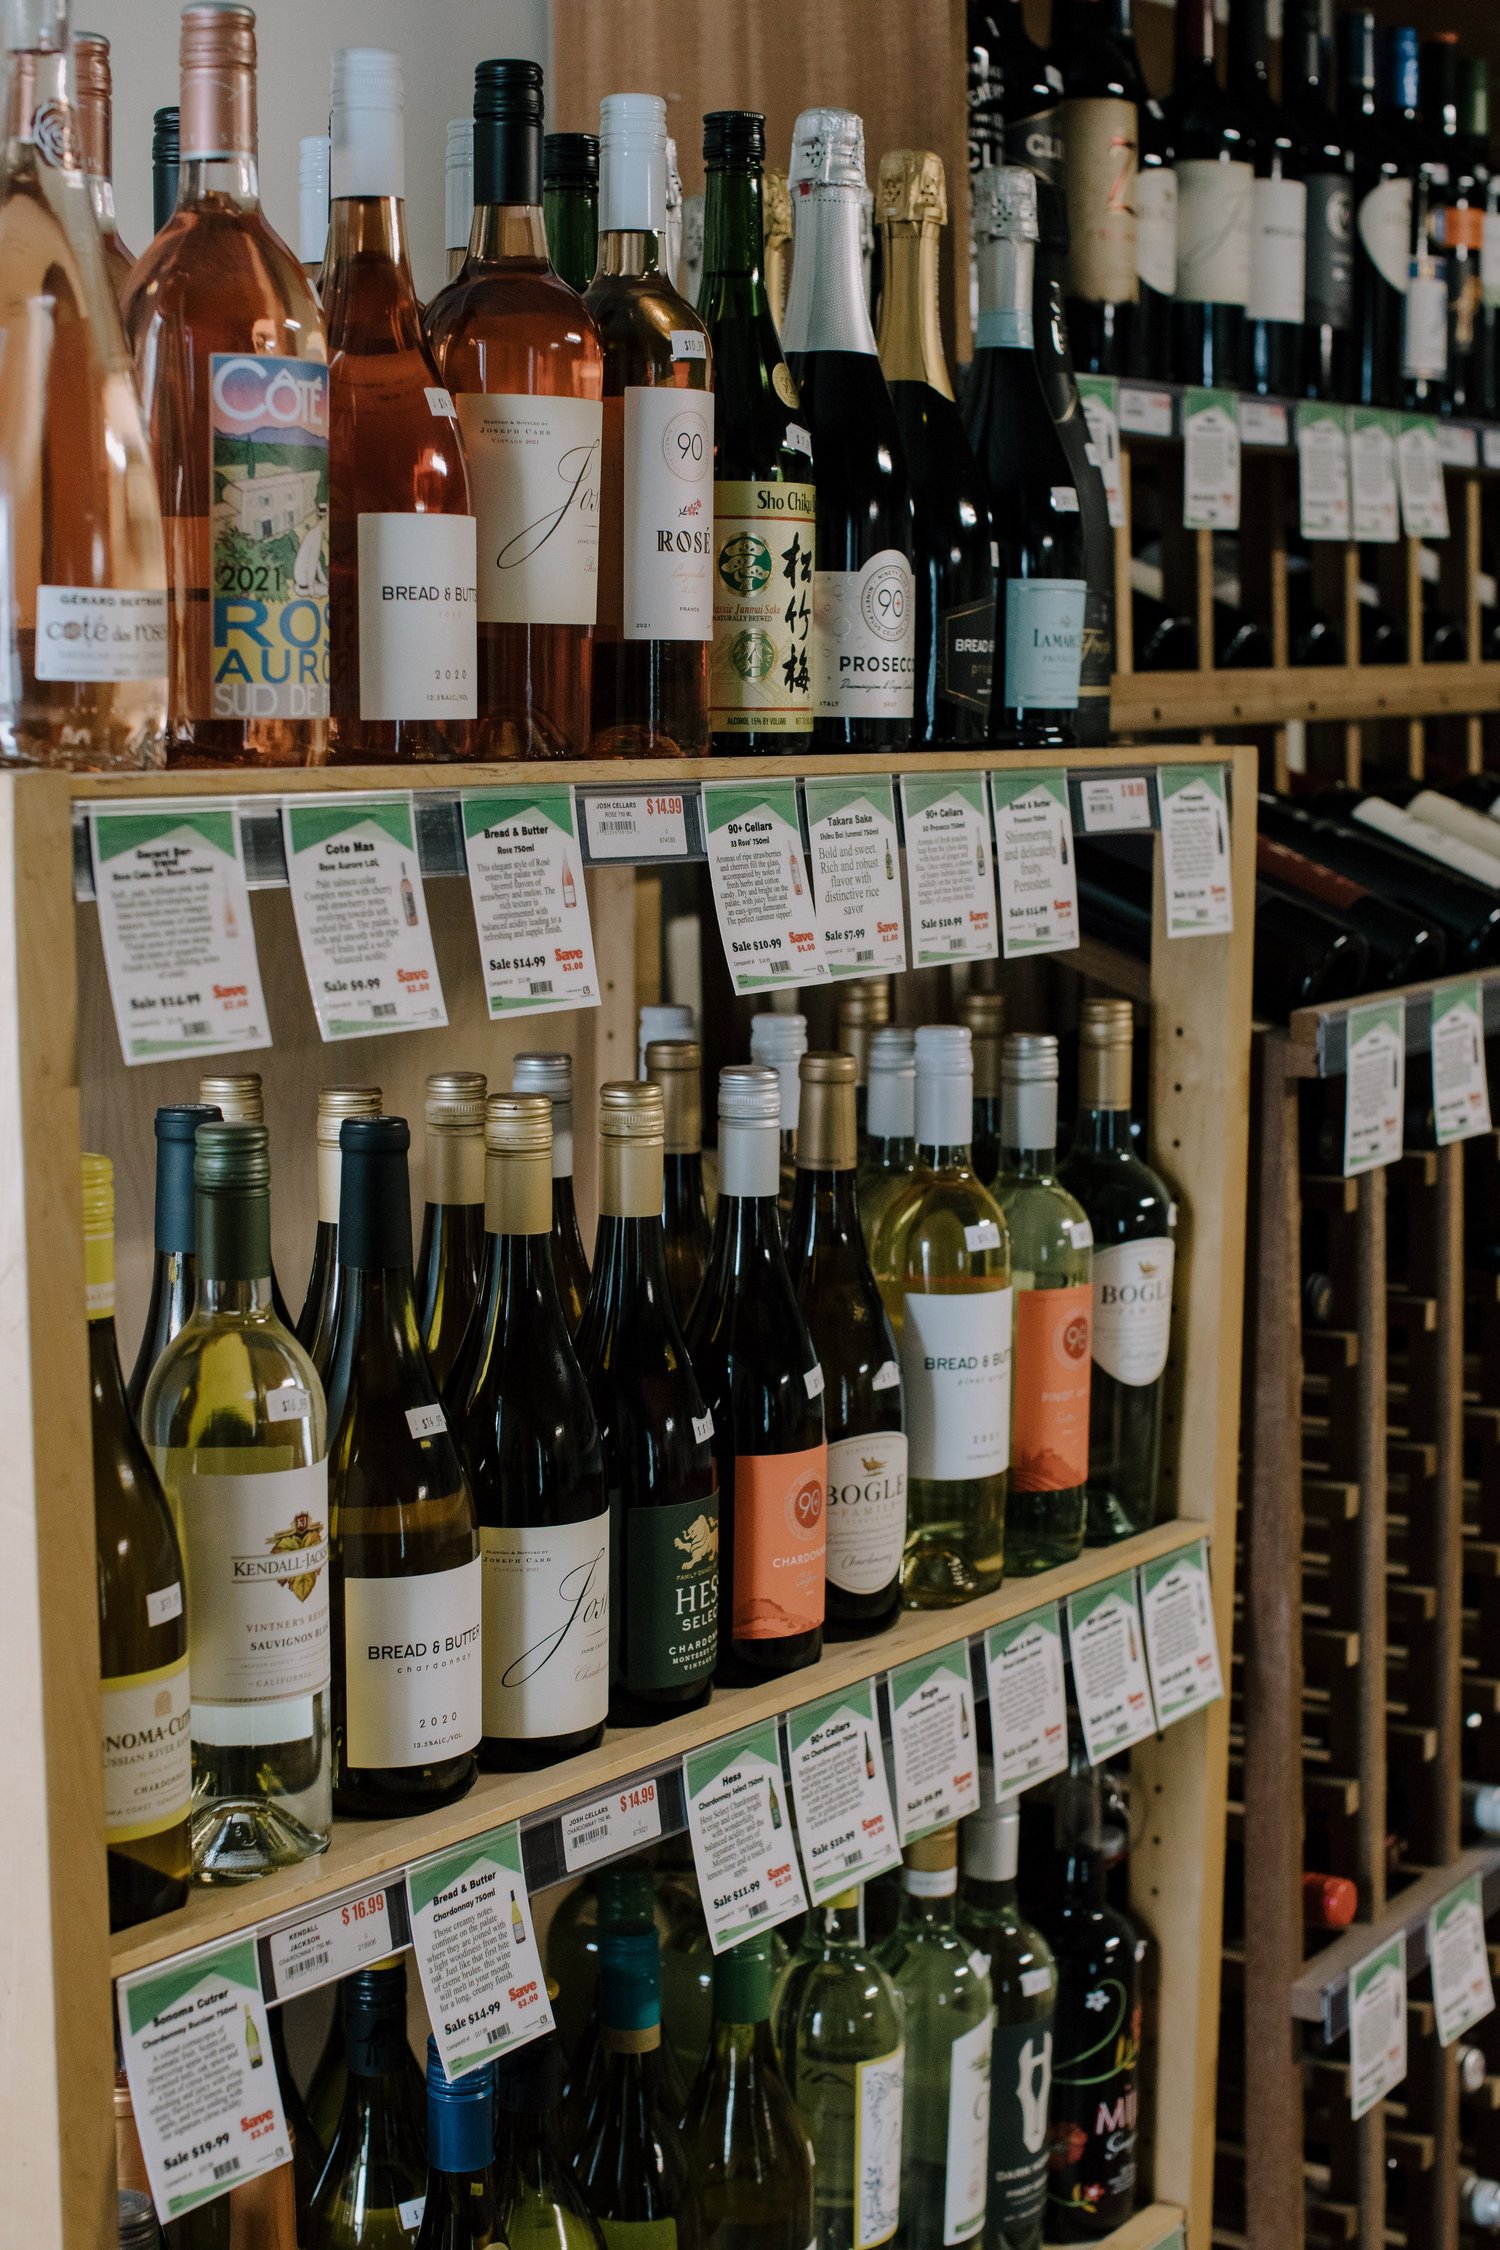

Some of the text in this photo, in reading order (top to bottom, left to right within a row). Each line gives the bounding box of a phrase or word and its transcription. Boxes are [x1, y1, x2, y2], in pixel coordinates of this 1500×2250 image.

[678, 432, 703, 461] 90
[757, 490, 784, 510] Sho
[656, 527, 710, 554] ROSÉ
[220, 566, 283, 592] 2021
[382, 586, 439, 600] BREAD
[445, 587, 451, 601] &
[713, 604, 781, 615] lassic Junmai Sake
[878, 589, 904, 617] 90
[781, 531, 813, 695] 松竹梅
[955, 638, 988, 652] BREAD
[435, 670, 467, 680] 2020
[214, 683, 278, 716] SUD
[290, 684, 317, 716] DE
[727, 716, 749, 726] ALCOHOL
[827, 815, 872, 827] Takara Sake
[925, 808, 964, 819] 90+ Cellars
[484, 826, 548, 839] Bread & Butter
[728, 822, 773, 834] 90+ Cellars
[325, 841, 374, 855] Cote Mas
[497, 843, 535, 855] Rose 750ml
[753, 836, 770, 845] 750ml
[818, 847, 838, 860] Bold
[839, 845, 853, 857] and
[820, 857, 879, 874] Rich and robust
[830, 872, 872, 887] flavor with
[825, 886, 880, 903] distinctive rice
[843, 904, 864, 916] savor
[1009, 907, 1025, 918] Sale
[1054, 899, 1072, 911] Save
[921, 917, 963, 929] Sale $10.99
[969, 910, 989, 922] Save
[825, 928, 865, 942] Sale $7.99
[877, 921, 898, 934] Save
[732, 938, 782, 952] Sale $10.99
[788, 931, 814, 944] Save
[489, 956, 546, 971] Sale $14.99
[555, 948, 583, 962] Save
[396, 968, 428, 983] Save
[324, 980, 349, 993] Sale
[925, 1356, 978, 1370] BREAD
[827, 1474, 904, 1506] BOGLE
[799, 1488, 820, 1519] 90
[251, 1632, 313, 1651] SAUVIGNON
[368, 1643, 427, 1660] BREAD
[433, 1640, 440, 1654] &
[397, 1652, 471, 1674] chardonnay
[420, 1711, 458, 1728] 2020
[810, 1722, 851, 1746] 90+ Cellars
[722, 1772, 741, 1786] Hess
[953, 1770, 973, 1787] Save
[699, 1791, 731, 1810] Chardonnay
[732, 1783, 747, 1794] Select
[569, 1806, 608, 1826] JOSH CELLARS
[862, 1813, 884, 1831] Save
[811, 1844, 829, 1858] Sale
[767, 1861, 791, 1881] Save
[433, 1871, 497, 1906] Bread & Butter
[714, 1880, 760, 1909] Sale $11.99
[352, 1893, 384, 1921] 16.99
[433, 1888, 496, 1922] Chardonnay 750ml
[433, 1907, 493, 1939] Those creamy notes
[289, 1924, 319, 1940] KENDALL
[432, 1915, 497, 1951] continue on the palate
[290, 1935, 320, 1952] JACKSON
[427, 1921, 506, 1963] where they are joined with
[433, 1960, 448, 1972] light
[450, 1944, 481, 1965] woodiness
[482, 1936, 497, 1948] from
[498, 1931, 508, 1940] the
[508, 1981, 537, 2002] Save
[153, 2004, 194, 2028] Sonoma
[444, 2001, 501, 2035] Sale $14.99
[240, 2108, 274, 2133] Save
[164, 2133, 230, 2172] Sale $19.99
